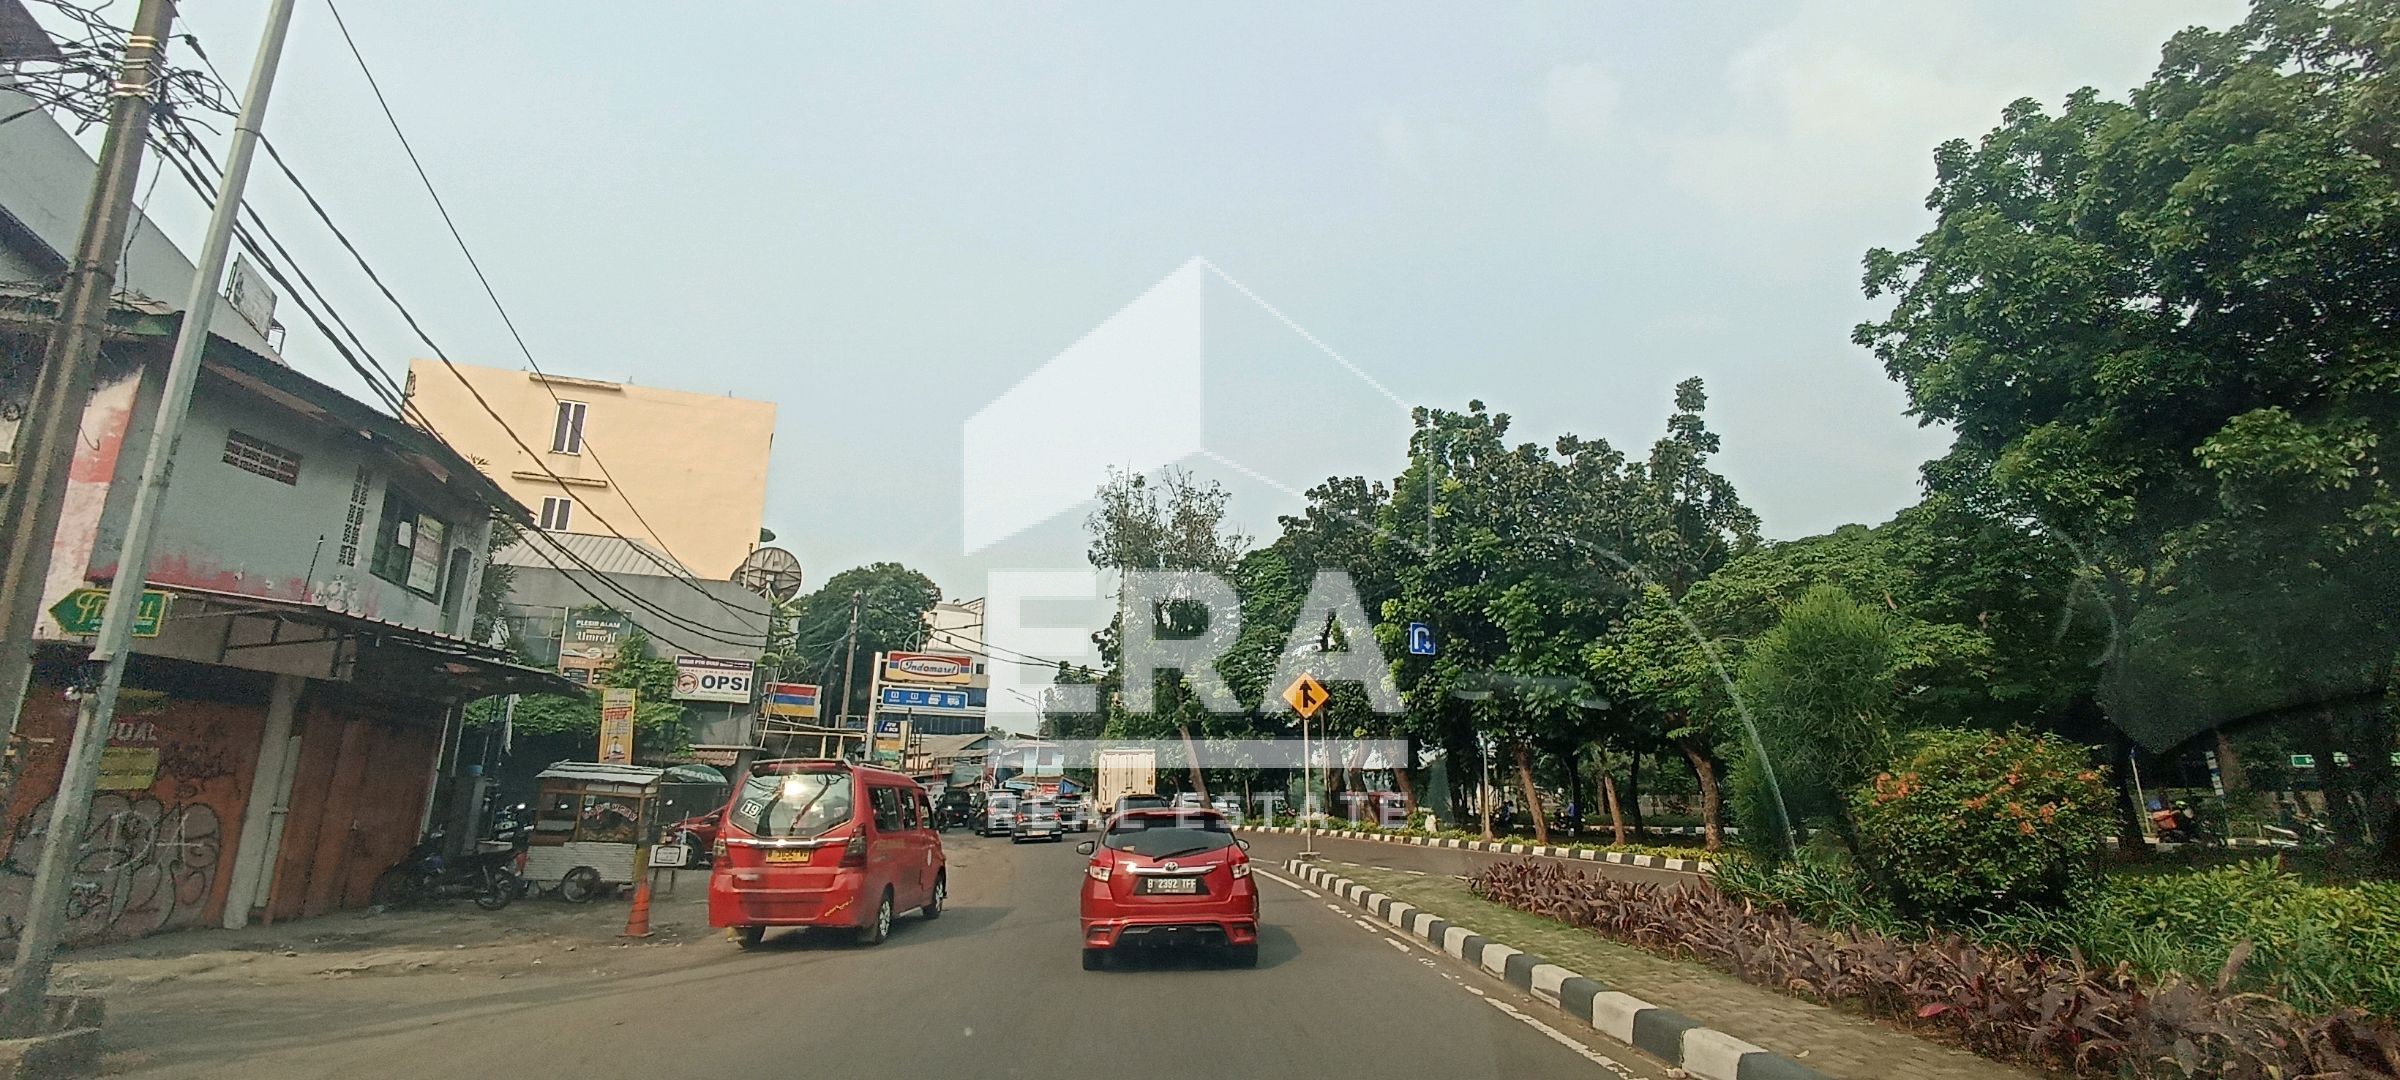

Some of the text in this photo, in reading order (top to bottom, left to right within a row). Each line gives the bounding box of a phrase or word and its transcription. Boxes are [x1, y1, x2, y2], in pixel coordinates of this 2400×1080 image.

[903, 661, 956, 674] Indomaret
[701, 674, 750, 691] OPSI
[745, 803, 759, 816] 19
[1147, 878, 1197, 889] B 2392 TFF
